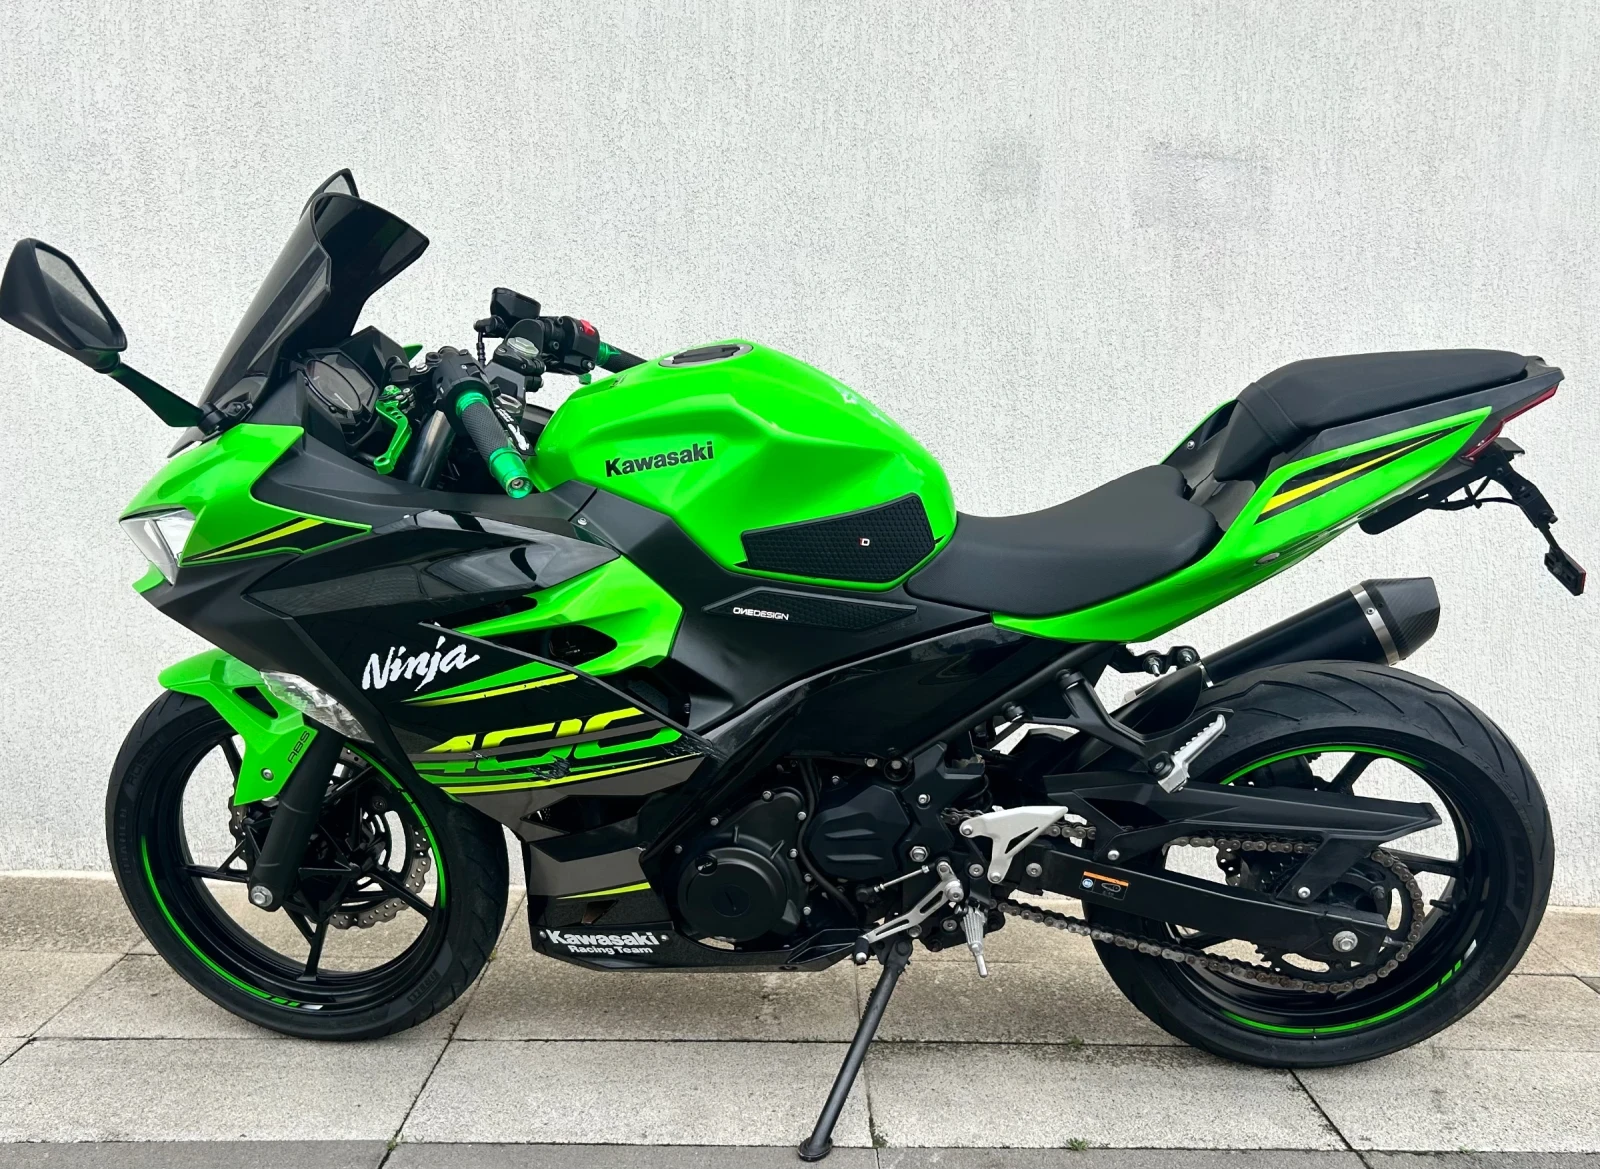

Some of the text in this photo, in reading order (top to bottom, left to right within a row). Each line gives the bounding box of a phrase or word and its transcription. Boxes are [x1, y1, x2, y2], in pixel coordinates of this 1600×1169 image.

[604, 440, 714, 478] Kawasaki
[733, 607, 789, 620] ONEDESIGN
[361, 635, 480, 691] Ninja
[287, 730, 310, 764] ABS
[546, 929, 660, 945] Kawasaki
[567, 945, 653, 955] Racing Team
